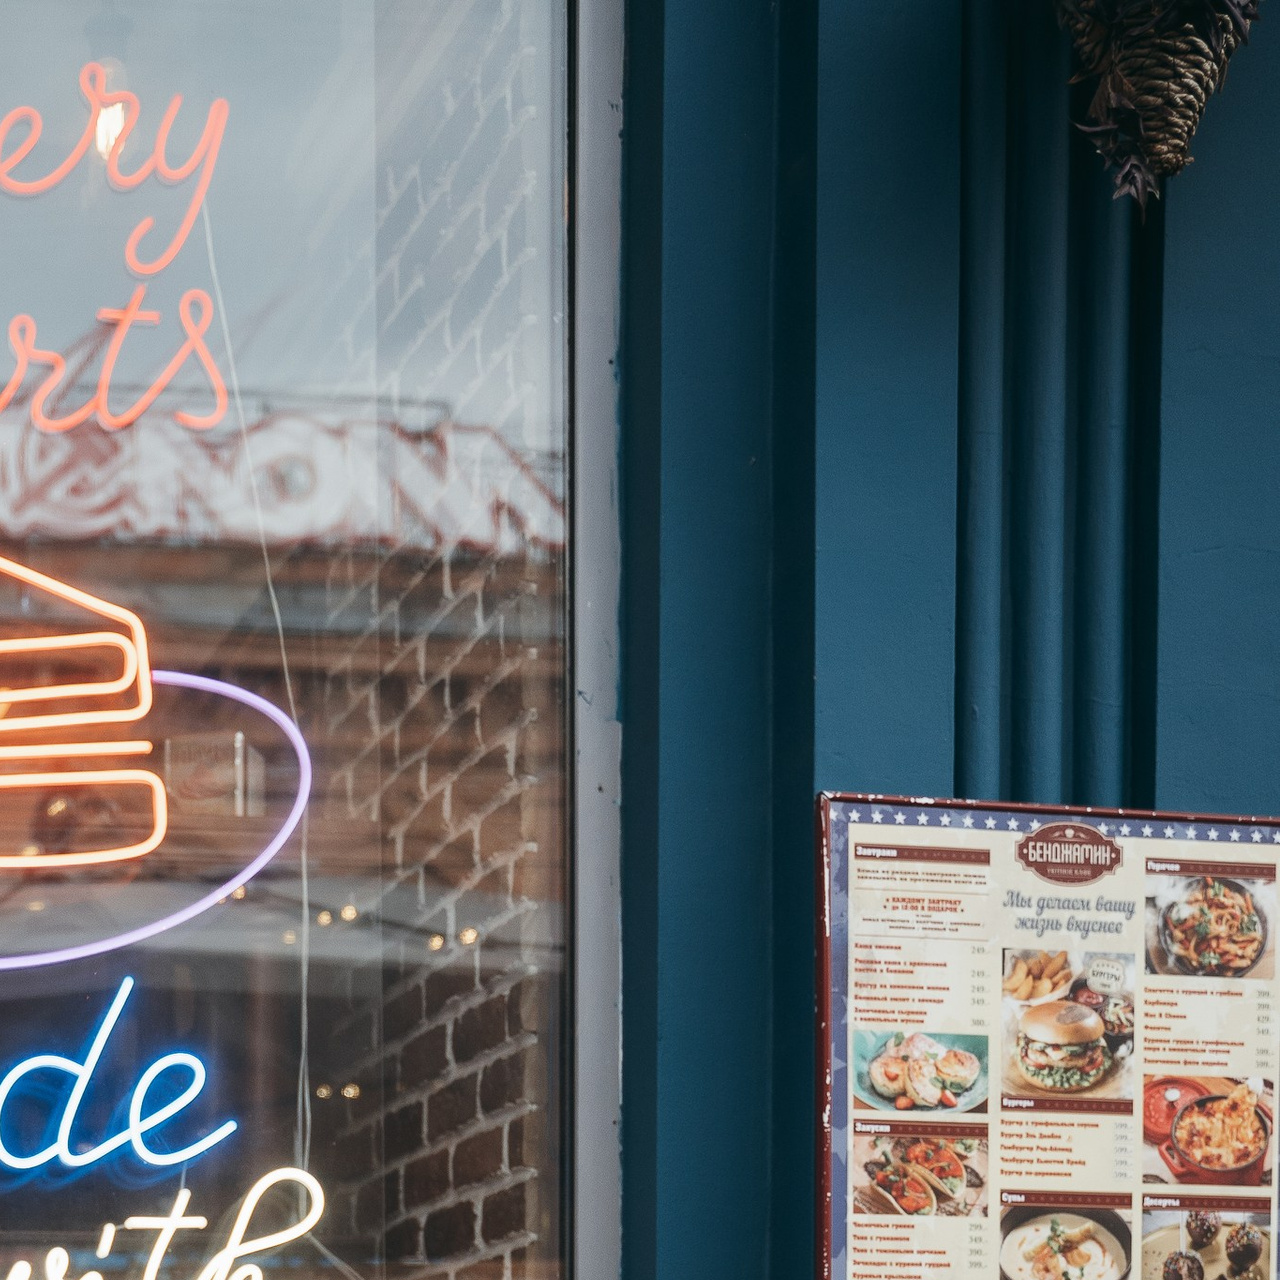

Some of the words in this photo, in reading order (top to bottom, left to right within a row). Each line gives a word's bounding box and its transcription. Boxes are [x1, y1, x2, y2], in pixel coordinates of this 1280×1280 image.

[1028, 841, 1111, 866] БЕНДЖАМИН
[1003, 890, 1032, 908] Мы
[1035, 896, 1091, 916] делаем
[1095, 895, 1136, 920] вашу
[1014, 916, 1062, 938] жизнь
[1066, 916, 1123, 940] вкуснее
